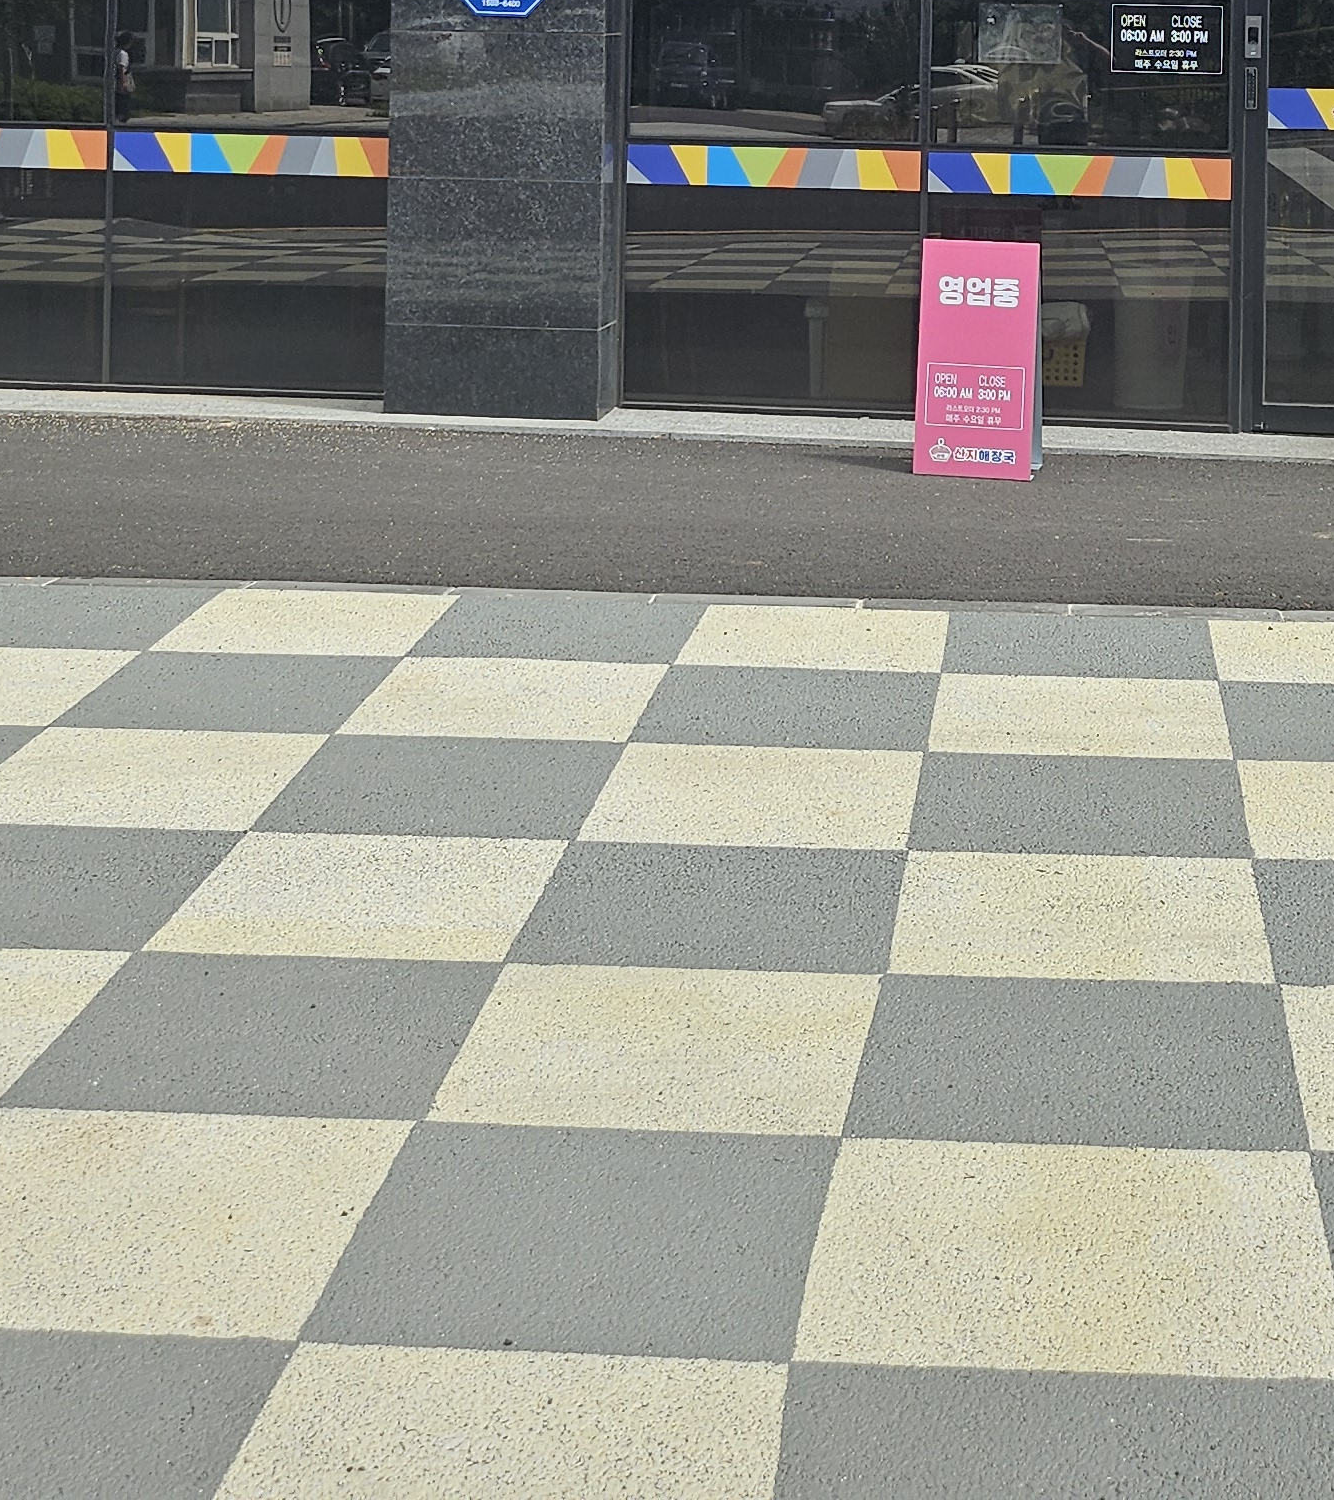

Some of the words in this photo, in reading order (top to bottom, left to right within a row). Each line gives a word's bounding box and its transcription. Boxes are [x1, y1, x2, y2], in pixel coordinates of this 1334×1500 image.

[1120, 14, 1147, 28] OPEN
[1171, 15, 1203, 29] CLOSE
[1120, 29, 1148, 42] 06:00
[1149, 30, 1165, 43] AM
[1170, 30, 1192, 43] 3:00
[1193, 31, 1209, 44] PM
[1169, 49, 1185, 58] 2:30
[1186, 50, 1198, 58] PM
[1134, 59, 1152, 70] 매주
[1154, 60, 1179, 70] 수요일
[1181, 60, 1199, 70] 휴무
[939, 275, 1020, 308] 영업중
[934, 372, 958, 385] OPEN
[978, 375, 1007, 388] CLOSE
[933, 385, 958, 398] 06:00
[959, 387, 973, 399] AM
[977, 388, 996, 400] 3:00
[998, 389, 1011, 401] PM
[962, 415, 985, 425] 수요일
[954, 448, 1016, 464] 산지해장국
